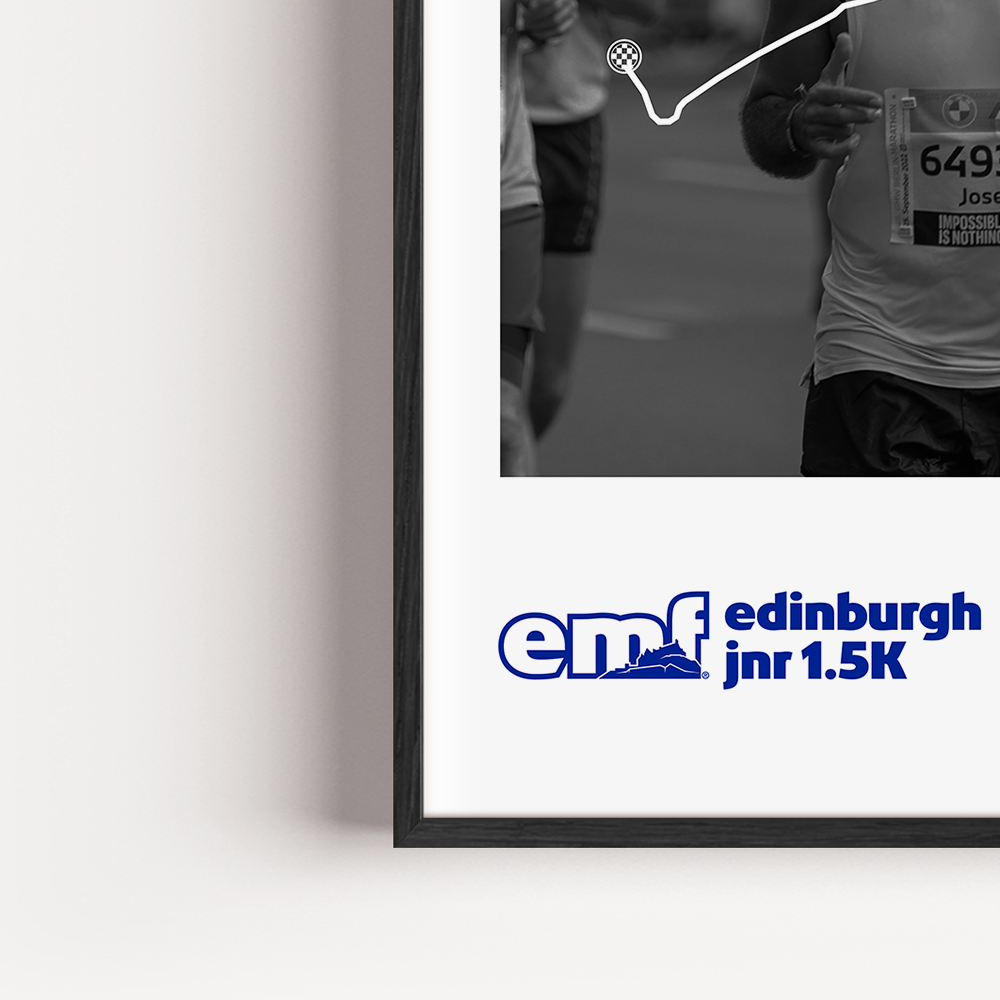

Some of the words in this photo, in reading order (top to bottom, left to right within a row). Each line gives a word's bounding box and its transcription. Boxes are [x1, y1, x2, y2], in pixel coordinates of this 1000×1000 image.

[938, 229, 951, 246] IS
[498, 591, 709, 680] emf
[725, 591, 982, 641] edinburgh
[723, 640, 793, 690] jnr
[801, 640, 908, 681] 1.5K
